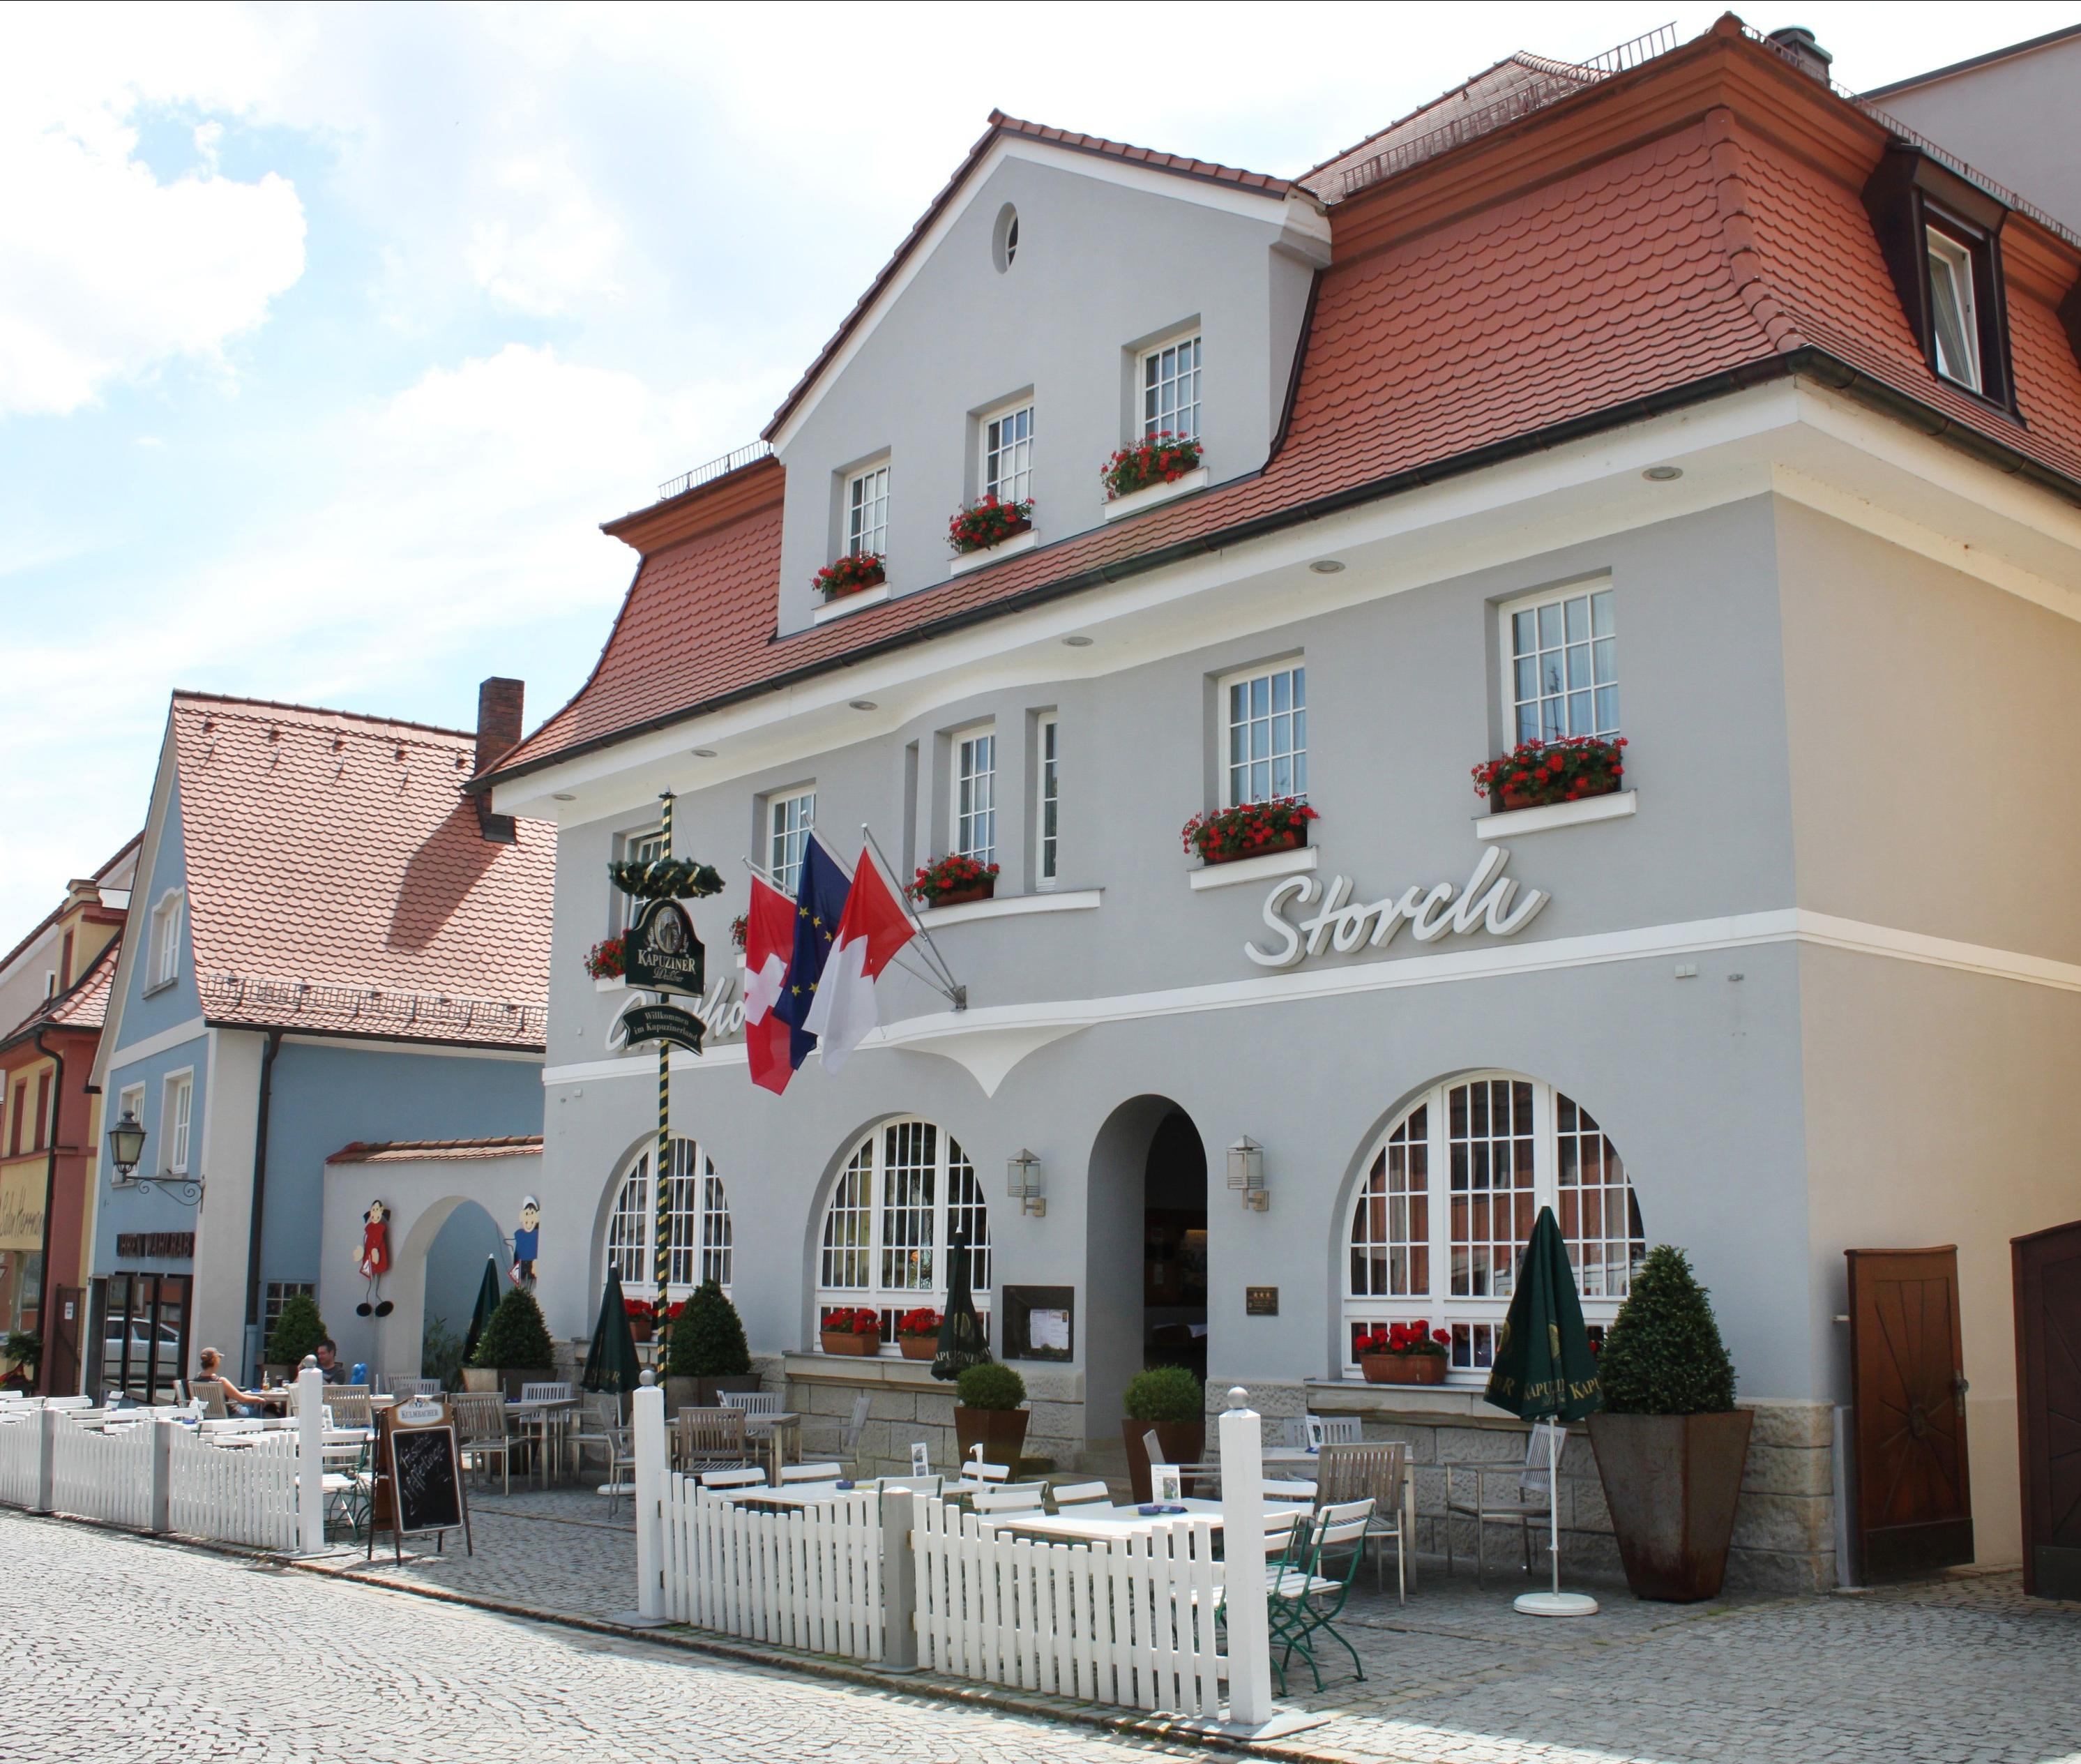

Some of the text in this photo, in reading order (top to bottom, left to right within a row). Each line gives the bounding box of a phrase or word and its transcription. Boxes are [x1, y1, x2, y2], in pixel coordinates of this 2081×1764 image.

[1244, 845, 1551, 967] Storch
[637, 949, 697, 975] KAPUZINER
[644, 1011, 689, 1026] Willkommen
[634, 1023, 698, 1042] im Kapuzinerland
